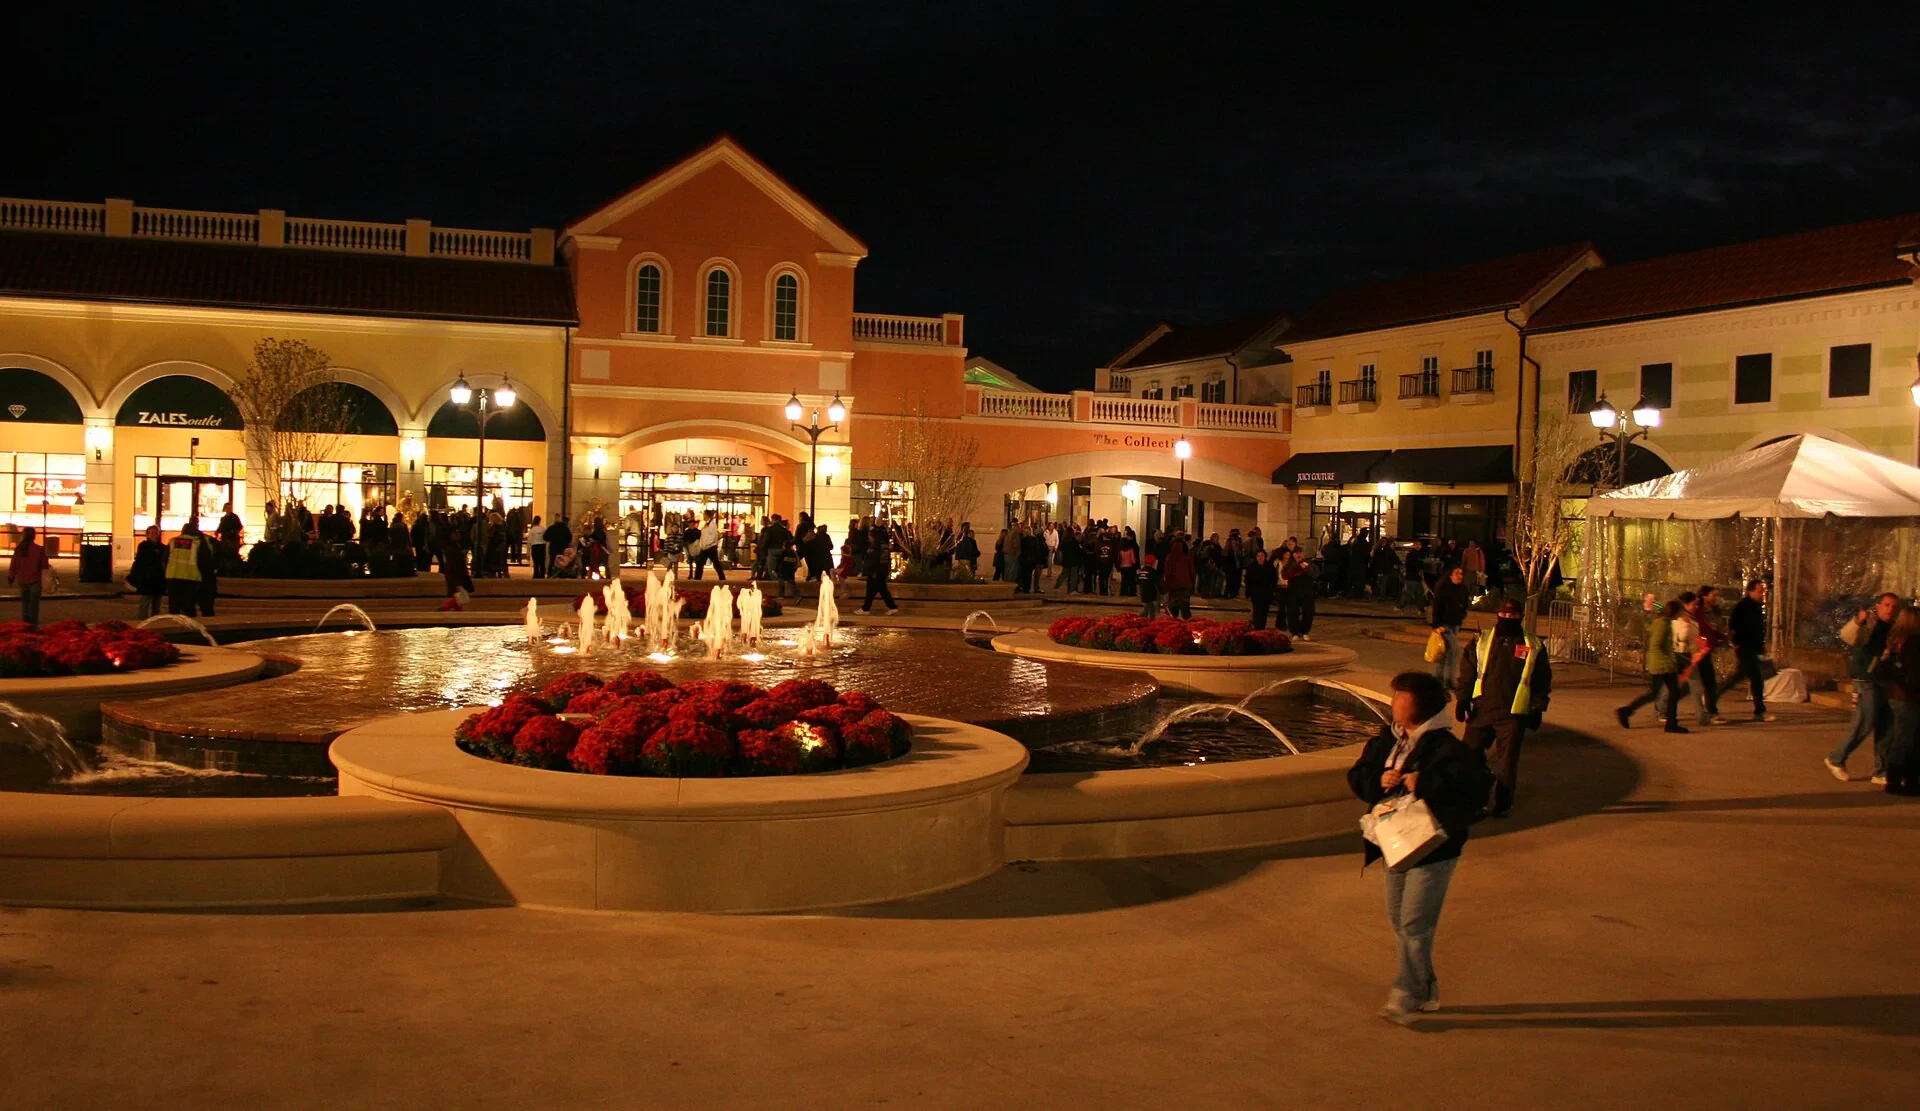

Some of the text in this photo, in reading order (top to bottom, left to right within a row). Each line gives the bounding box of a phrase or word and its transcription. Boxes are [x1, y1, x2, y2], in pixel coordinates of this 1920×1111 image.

[1095, 435, 1176, 448] The Collecti
[675, 456, 748, 467] KENNETH COLE
[1297, 472, 1335, 483] JUICY COUTURE
